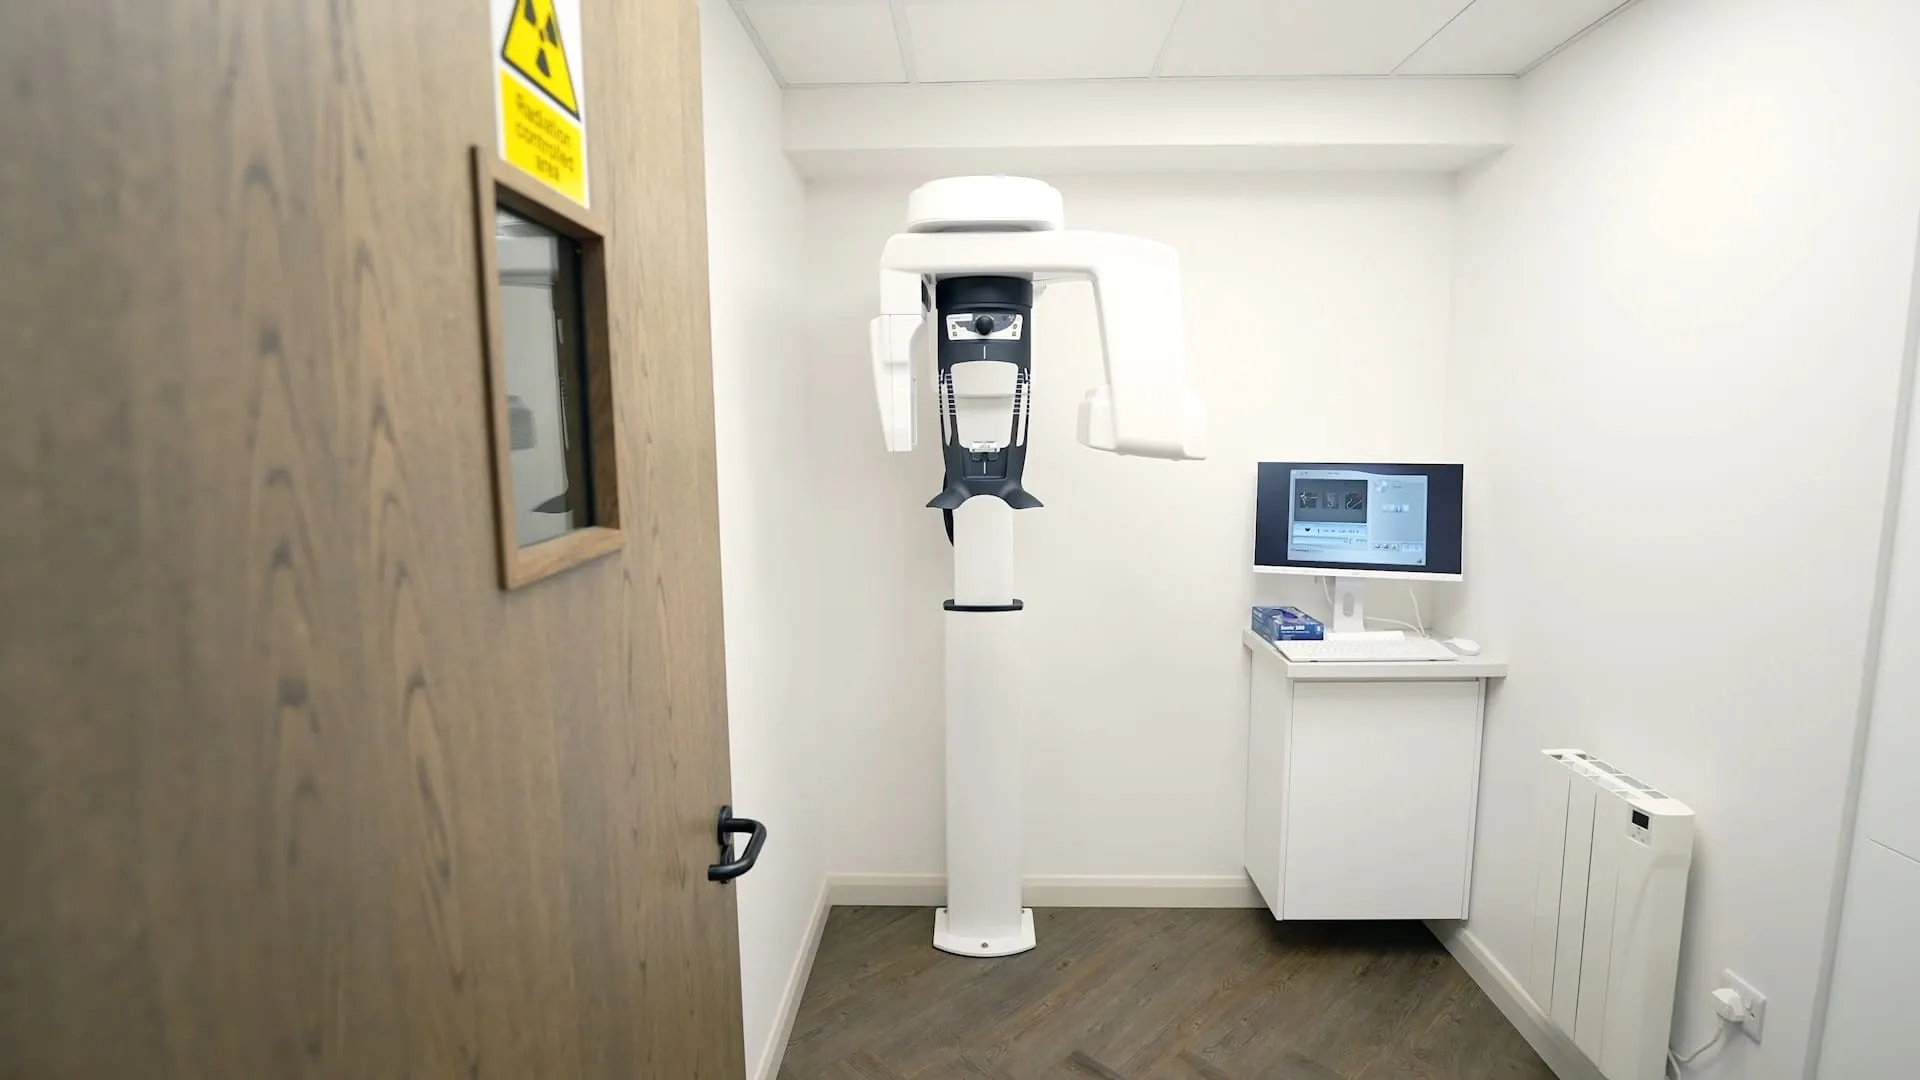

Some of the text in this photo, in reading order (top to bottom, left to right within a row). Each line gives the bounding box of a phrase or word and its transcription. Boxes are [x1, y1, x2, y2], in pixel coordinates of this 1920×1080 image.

[516, 92, 570, 148] Radiation
[516, 122, 575, 173] controlled
[536, 155, 560, 181] area
